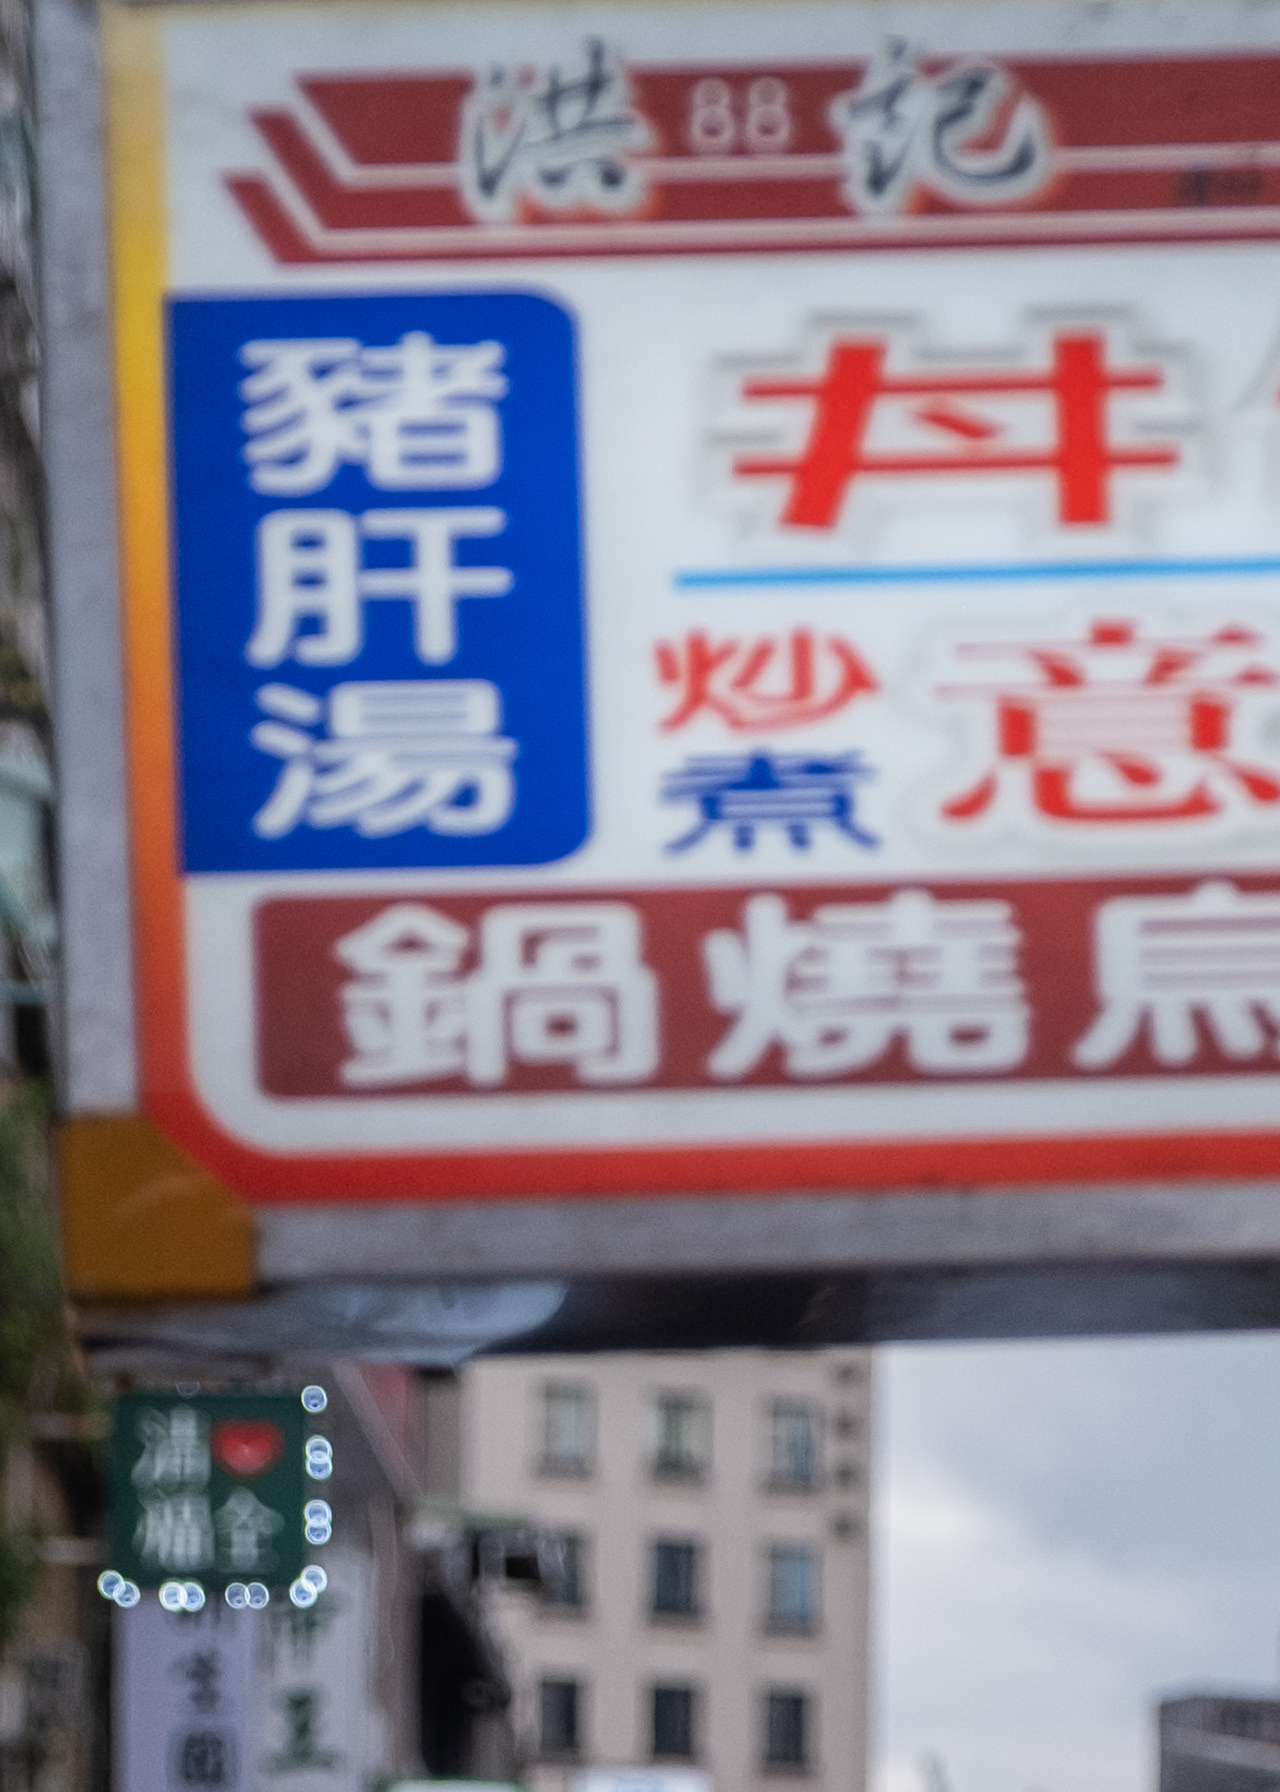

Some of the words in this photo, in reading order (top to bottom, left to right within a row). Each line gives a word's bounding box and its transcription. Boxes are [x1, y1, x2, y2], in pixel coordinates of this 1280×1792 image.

[470, 40, 638, 200] 洪
[690, 78, 790, 152] 88
[848, 40, 1040, 196] 記
[239, 330, 519, 840] 豬肝湯
